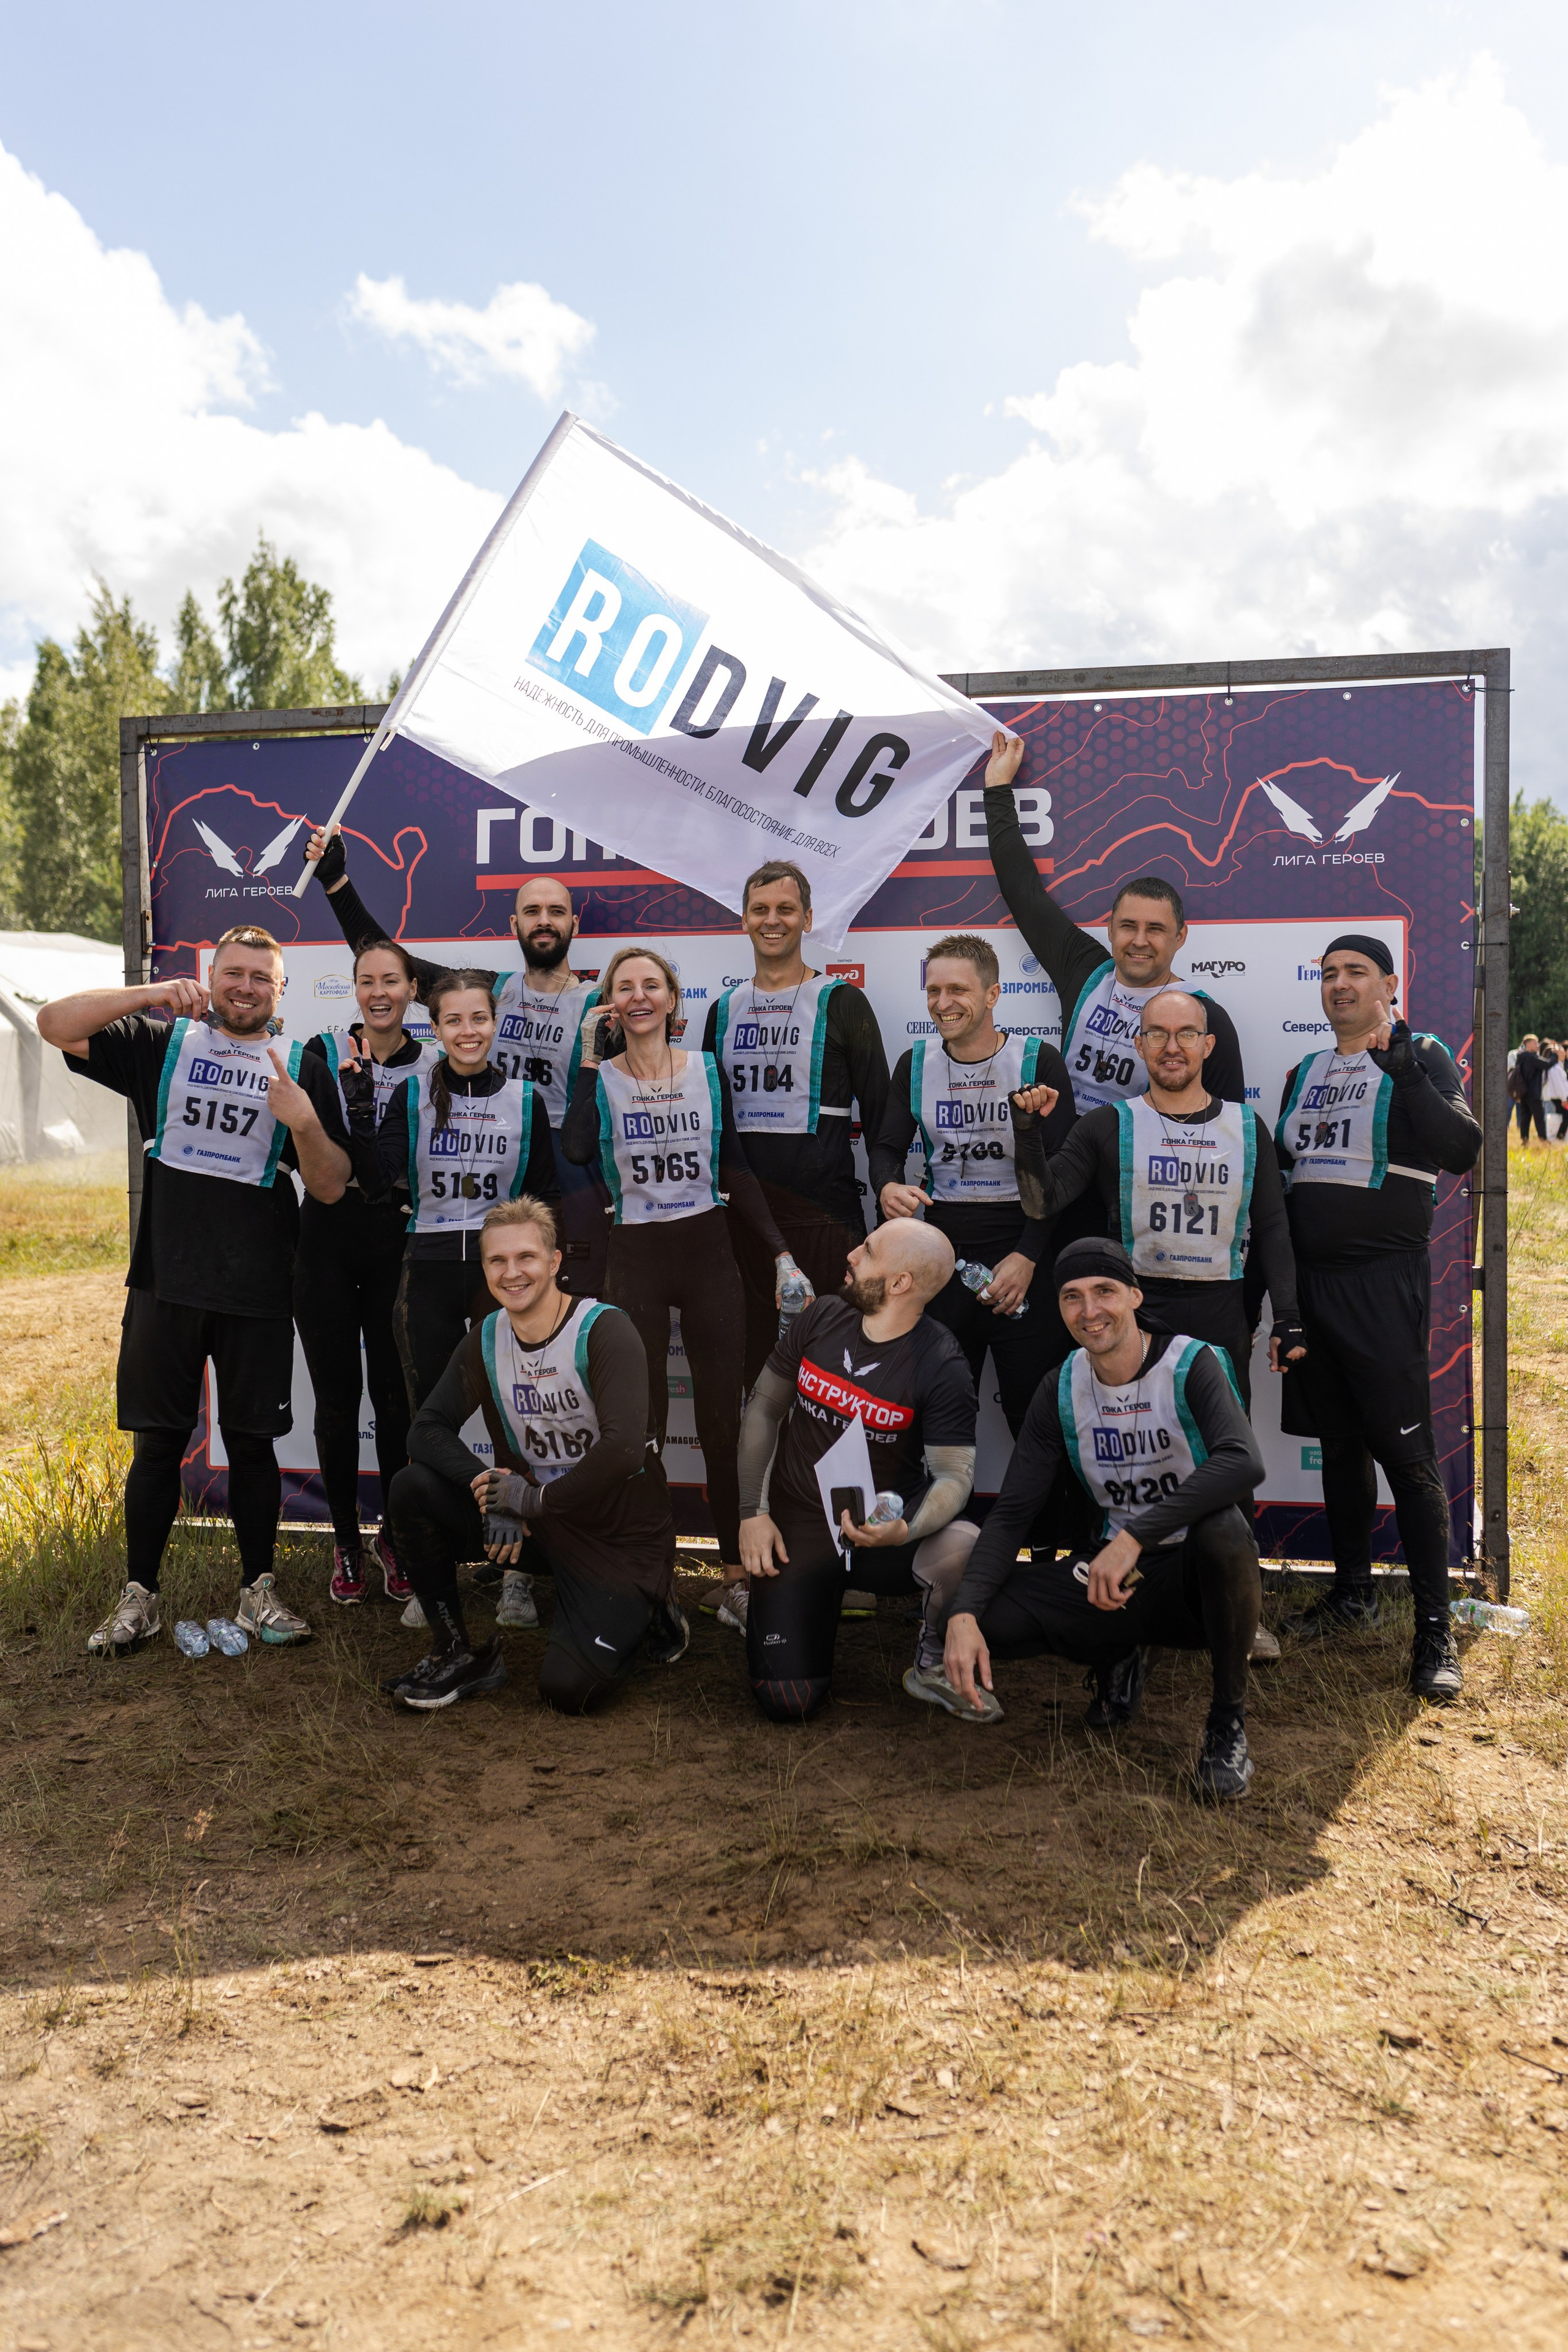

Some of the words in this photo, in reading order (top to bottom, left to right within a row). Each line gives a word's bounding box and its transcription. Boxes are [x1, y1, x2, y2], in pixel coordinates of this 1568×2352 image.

[545, 568, 911, 818] RODVIG
[514, 676, 584, 726] НАДЕЖНОСТЬ
[583, 718, 609, 740] ДЛЯ
[607, 731, 706, 796] ПРОМЫШЛЕННОСТИ,
[705, 785, 796, 842] БЛАГОСОСТОЯНИЕ
[791, 832, 818, 849] ДЛЯ
[814, 840, 841, 858] ВСЕХ
[1273, 854, 1316, 866] ЛИГА
[1323, 853, 1385, 865] ГЕРОЕВ
[205, 888, 238, 899] ЛИГА
[243, 886, 293, 897] ГЕРОЕВ
[1191, 960, 1246, 973] МАГУРО
[316, 982, 351, 990] Московский
[501, 1017, 564, 1043] RODVIG
[736, 1026, 800, 1046] RODVIG
[233, 1049, 261, 1061] ГЕРОЕВ
[1075, 1043, 1136, 1087] 5160
[192, 1061, 269, 1092] RODVIG
[1304, 1082, 1368, 1107] RODVIG
[183, 1096, 260, 1137] 5157
[626, 1111, 700, 1136] RODVIG
[939, 1101, 1008, 1125] RODVIG
[432, 1132, 507, 1155] RODVIG
[197, 1149, 241, 1163] ГАЗПРОМБАНК
[631, 1150, 700, 1185] 5165
[1152, 1159, 1229, 1185] RODVIG
[657, 1200, 695, 1210] ГАЗПРОМБАНК
[1150, 1201, 1219, 1235] 6121
[1170, 1254, 1213, 1264] ГАЗПРОМБАНК
[535, 1366, 557, 1376] ГЕРОЕВ
[1124, 1401, 1152, 1411] ГЕРОЕВ
[1096, 1428, 1170, 1458] RODVIG
